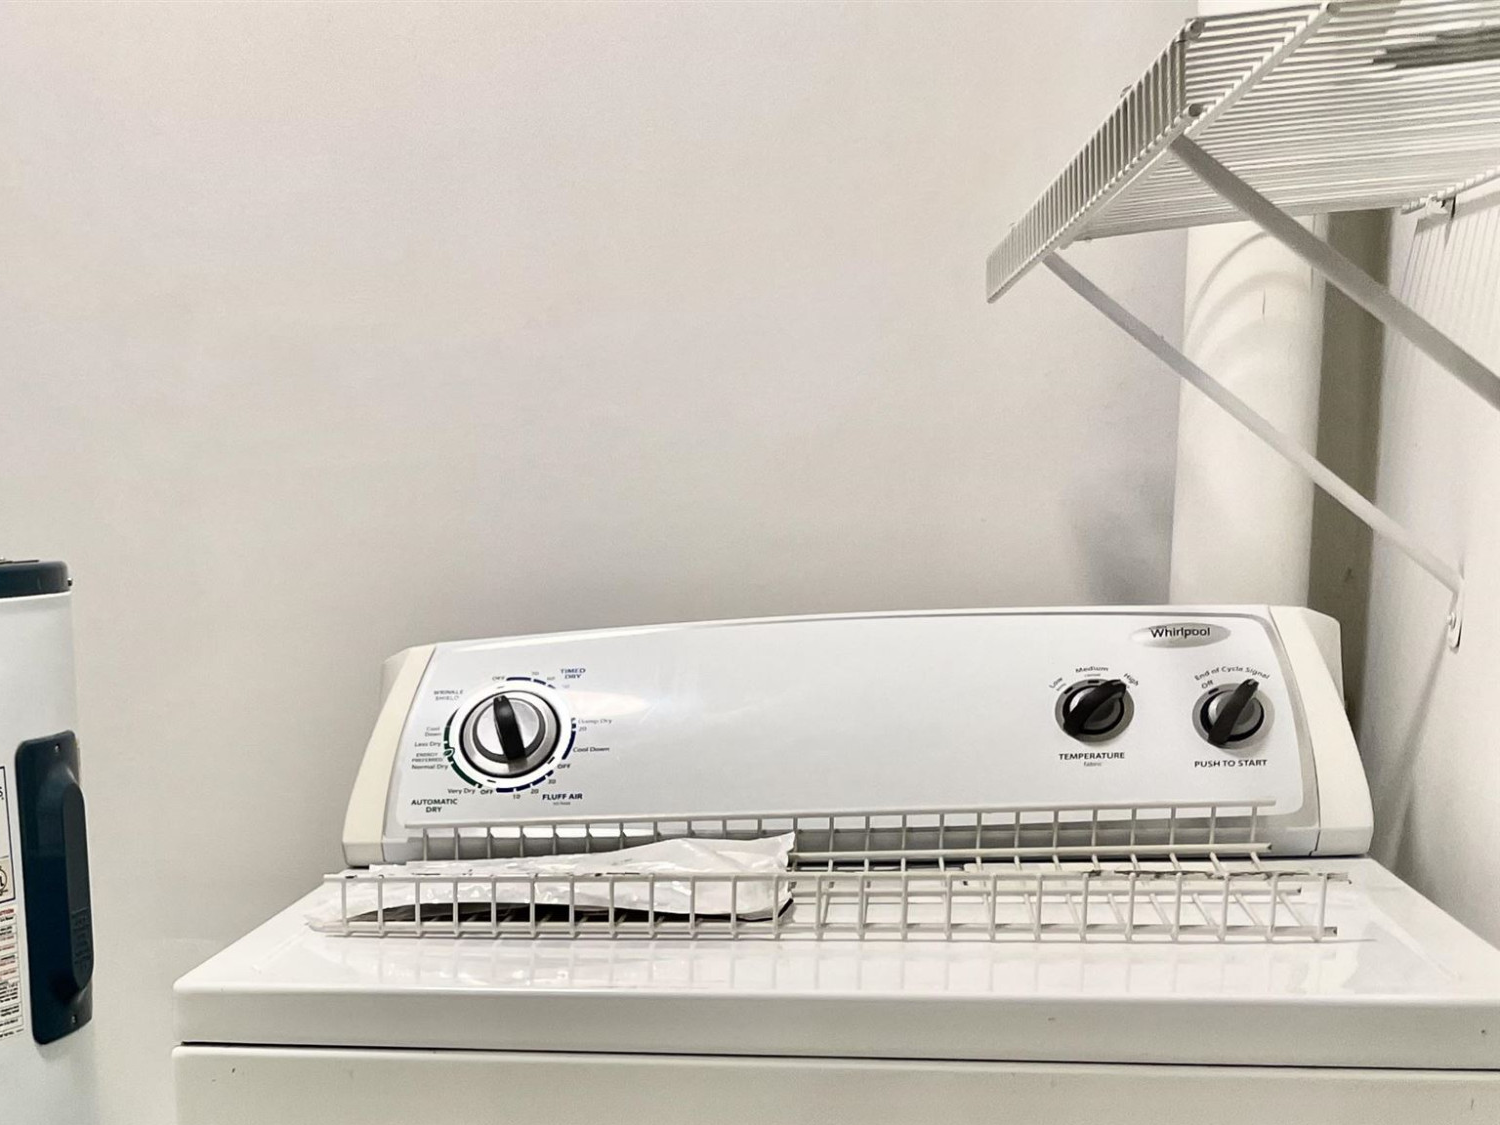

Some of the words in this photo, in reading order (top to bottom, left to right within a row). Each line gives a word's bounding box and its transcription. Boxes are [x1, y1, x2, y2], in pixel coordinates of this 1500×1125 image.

[1150, 627, 1211, 639] Whirlpool
[1194, 671, 1210, 681] End
[1245, 667, 1271, 680] Signal
[1049, 677, 1063, 689] Low
[1124, 673, 1139, 686] High
[1201, 680, 1214, 689] Off
[1059, 752, 1125, 760] TEMPERATURE
[1194, 760, 1220, 768] PUSH
[1222, 760, 1237, 768] TO
[1239, 759, 1268, 767] START
[411, 798, 458, 806] AUTOMATIC
